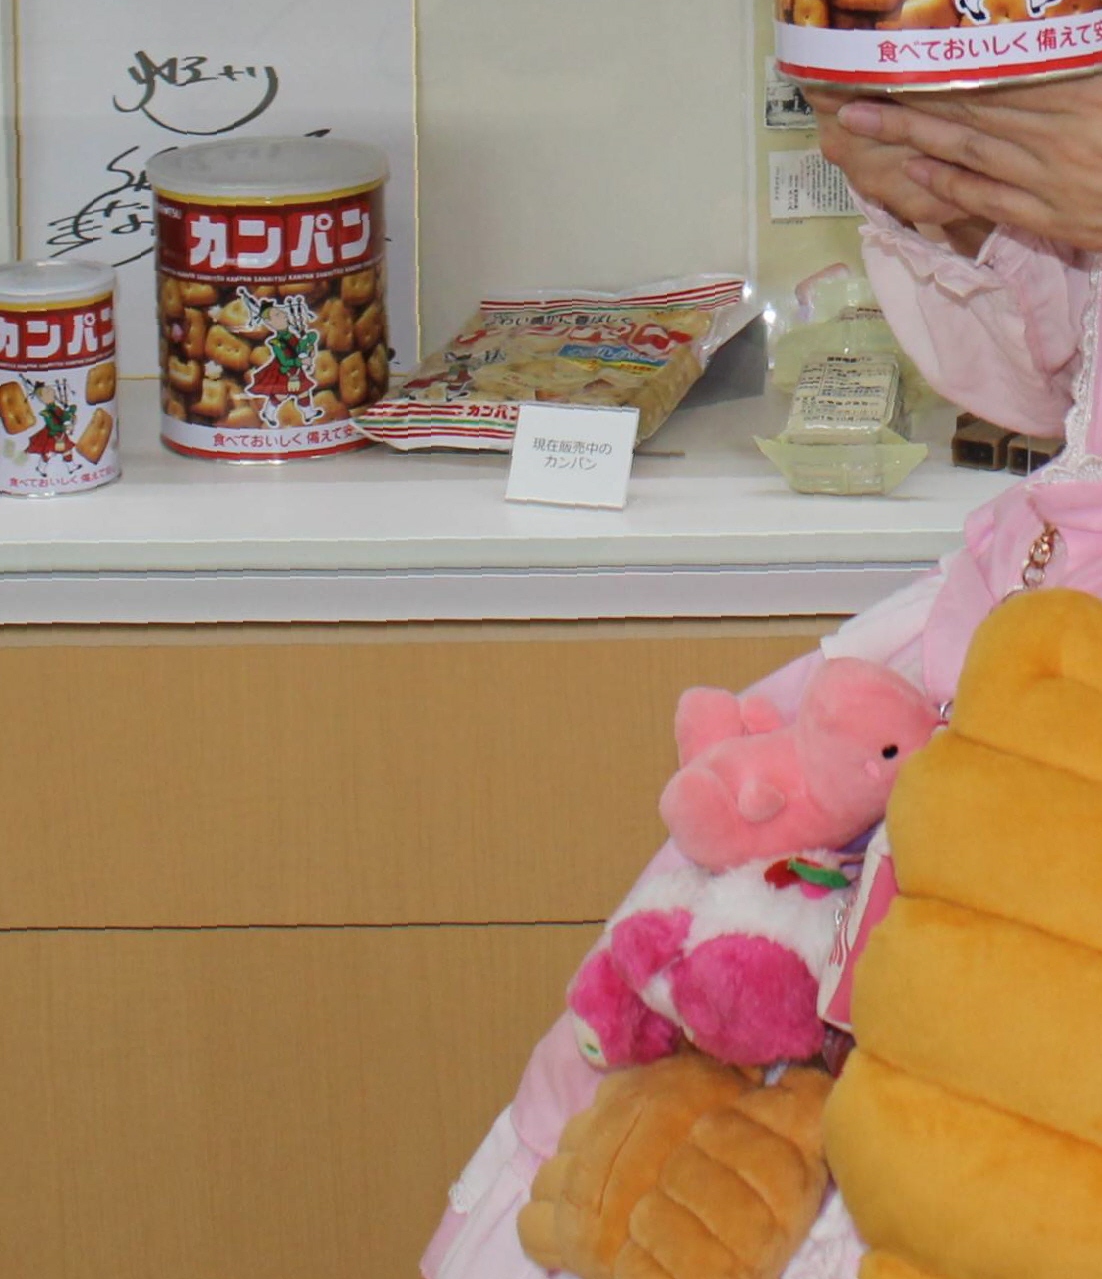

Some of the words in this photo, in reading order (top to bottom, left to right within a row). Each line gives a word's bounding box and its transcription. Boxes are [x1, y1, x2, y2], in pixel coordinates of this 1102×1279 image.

[877, 30, 1028, 64] 食べておいしく
[189, 208, 370, 269] カンパン
[213, 432, 302, 448] 食べておいしく
[544, 455, 598, 470] カンパン
